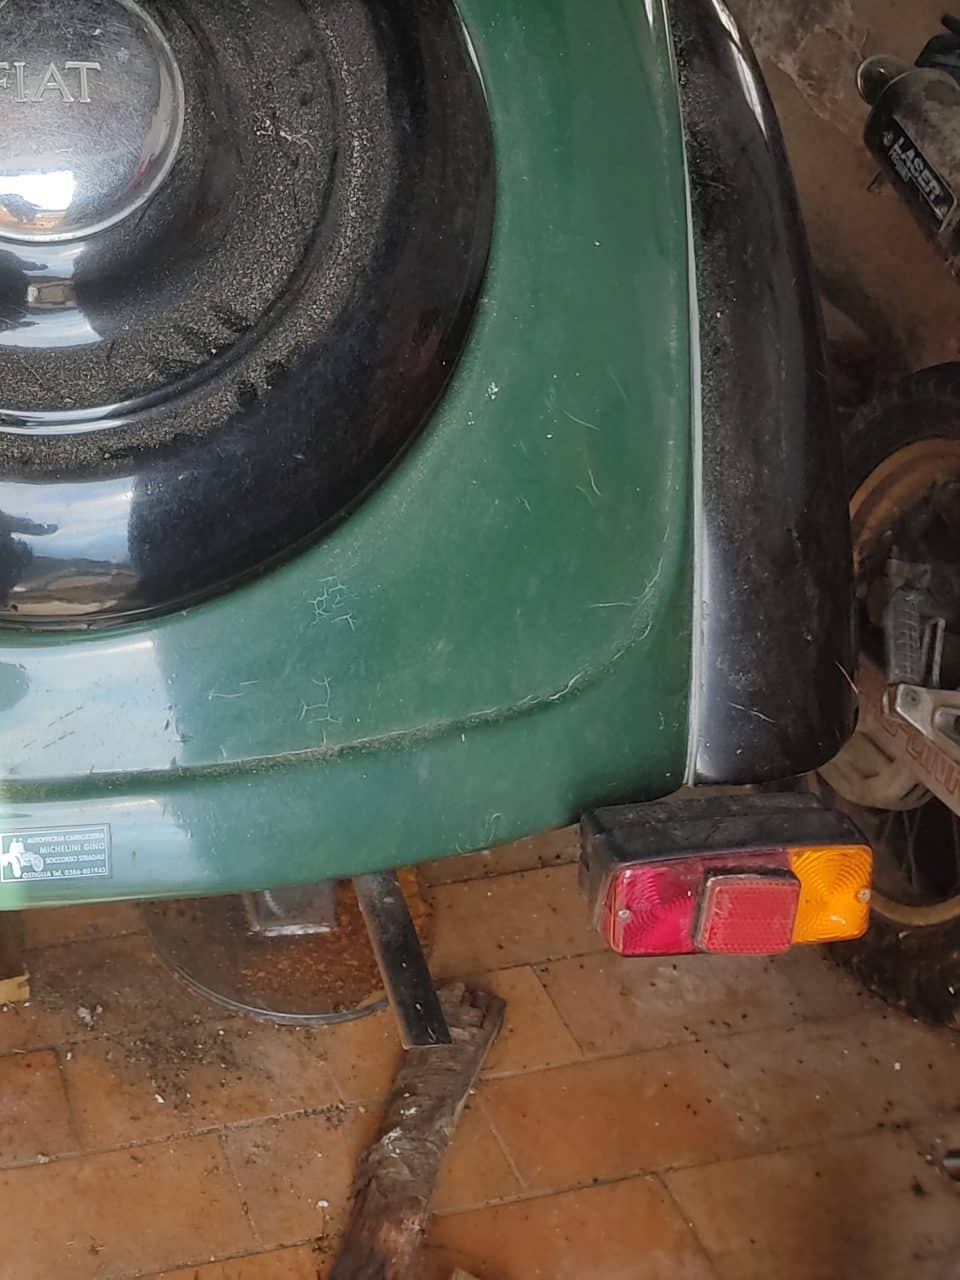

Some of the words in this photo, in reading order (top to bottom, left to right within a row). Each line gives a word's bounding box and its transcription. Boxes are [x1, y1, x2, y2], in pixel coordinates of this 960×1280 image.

[895, 136, 941, 201] LASER
[39, 844, 81, 854] MICHELINI
[83, 842, 105, 850] GINO
